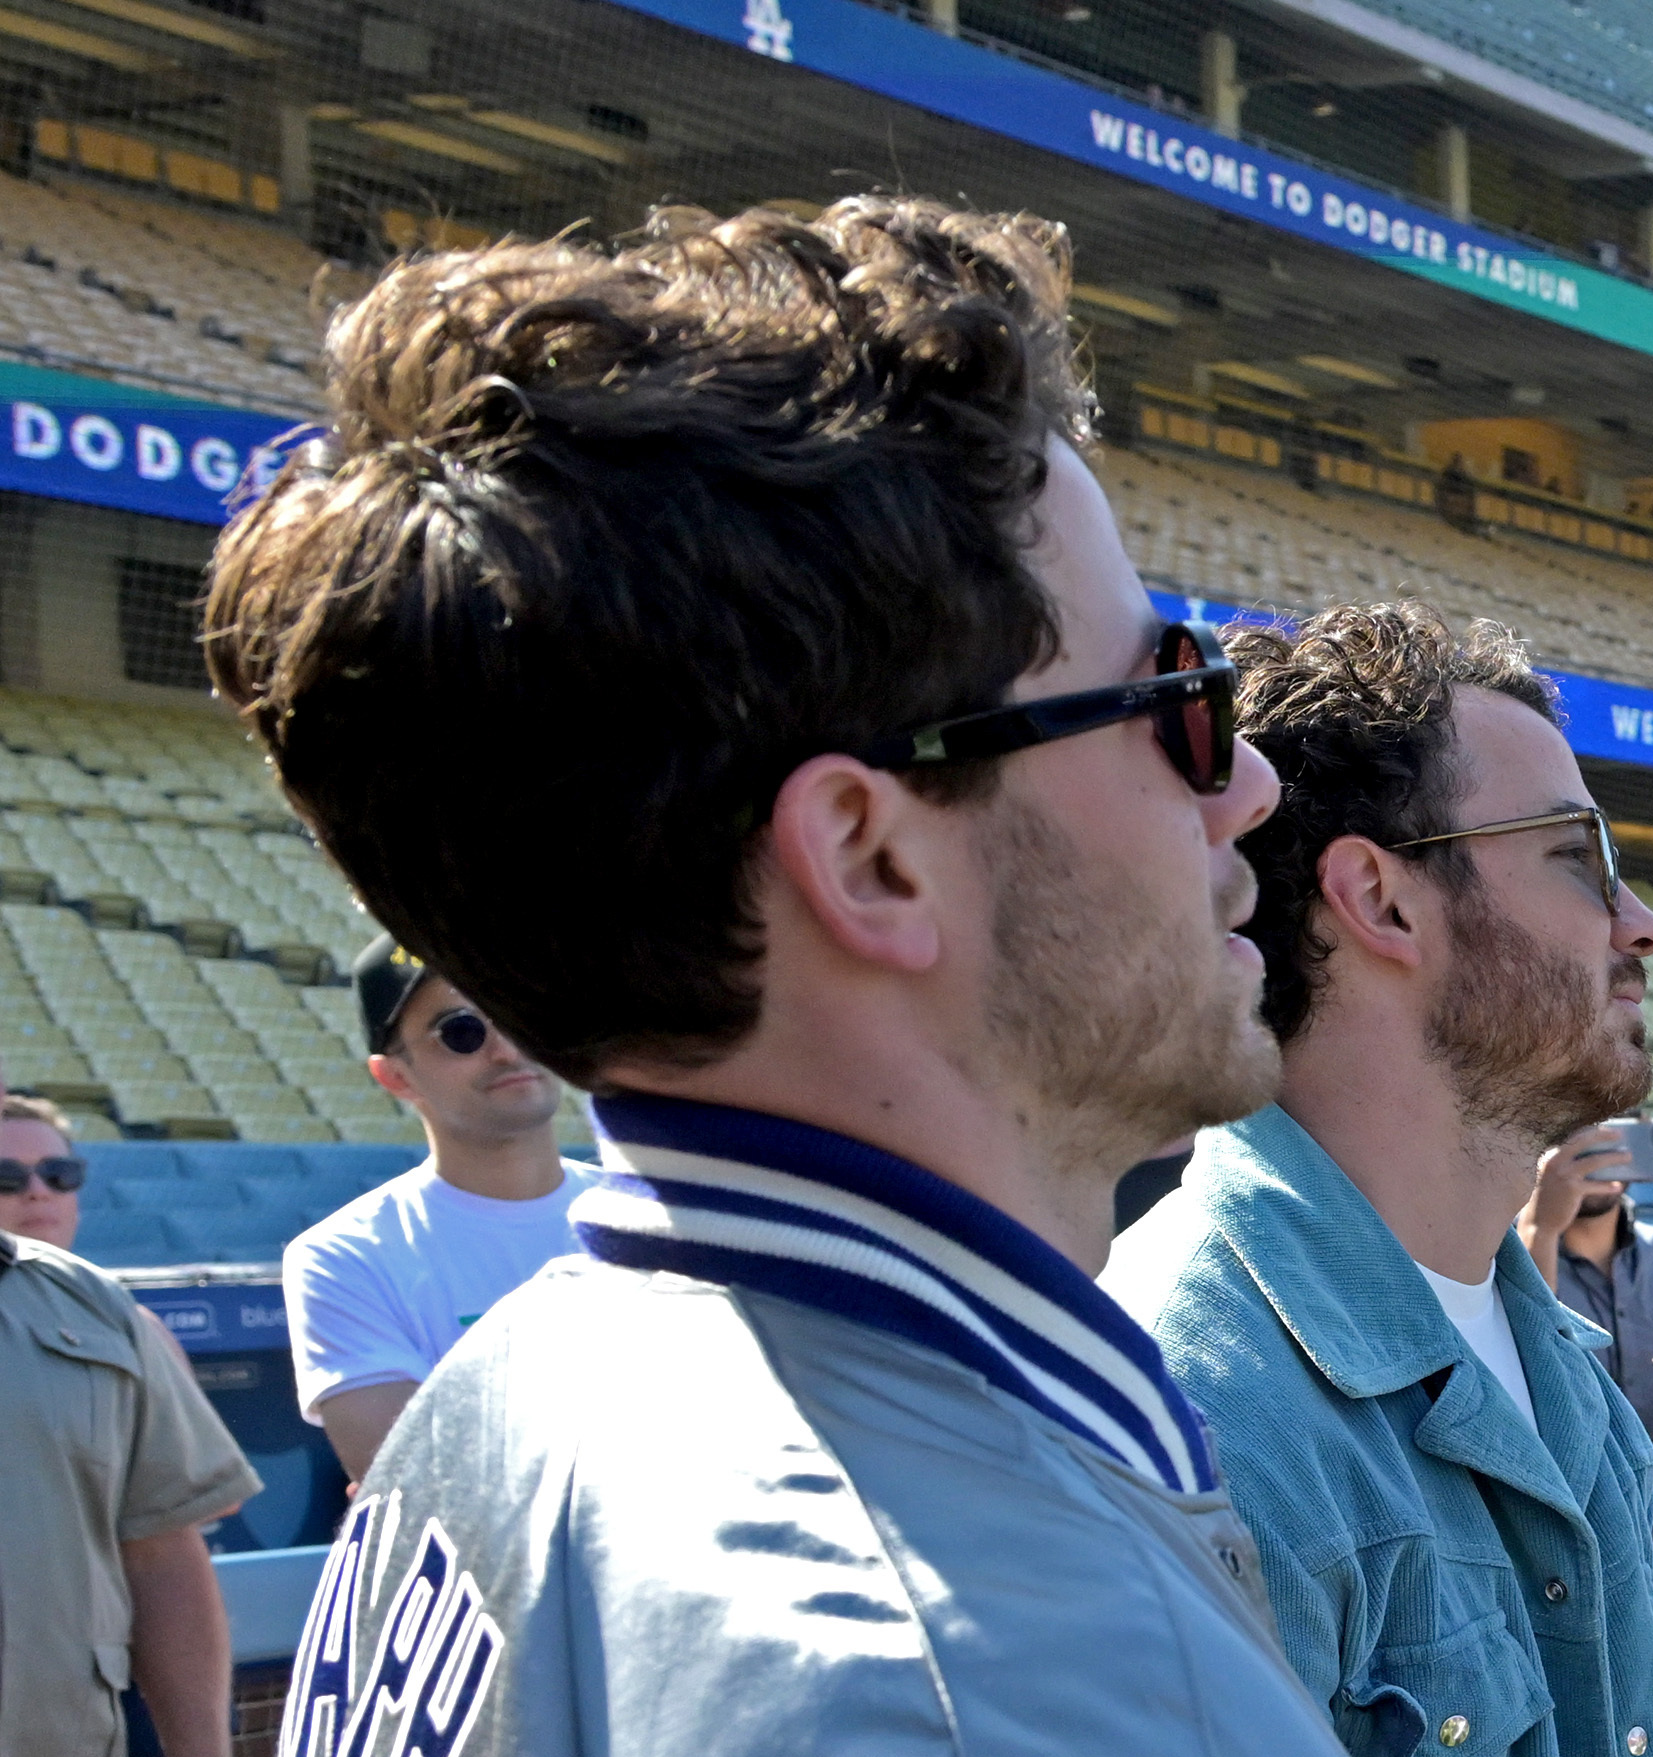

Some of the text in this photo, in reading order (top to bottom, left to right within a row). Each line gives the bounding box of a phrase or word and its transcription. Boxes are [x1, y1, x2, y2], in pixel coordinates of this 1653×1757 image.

[1090, 109, 1579, 312] WELCOME TO DODGER STADIUM
